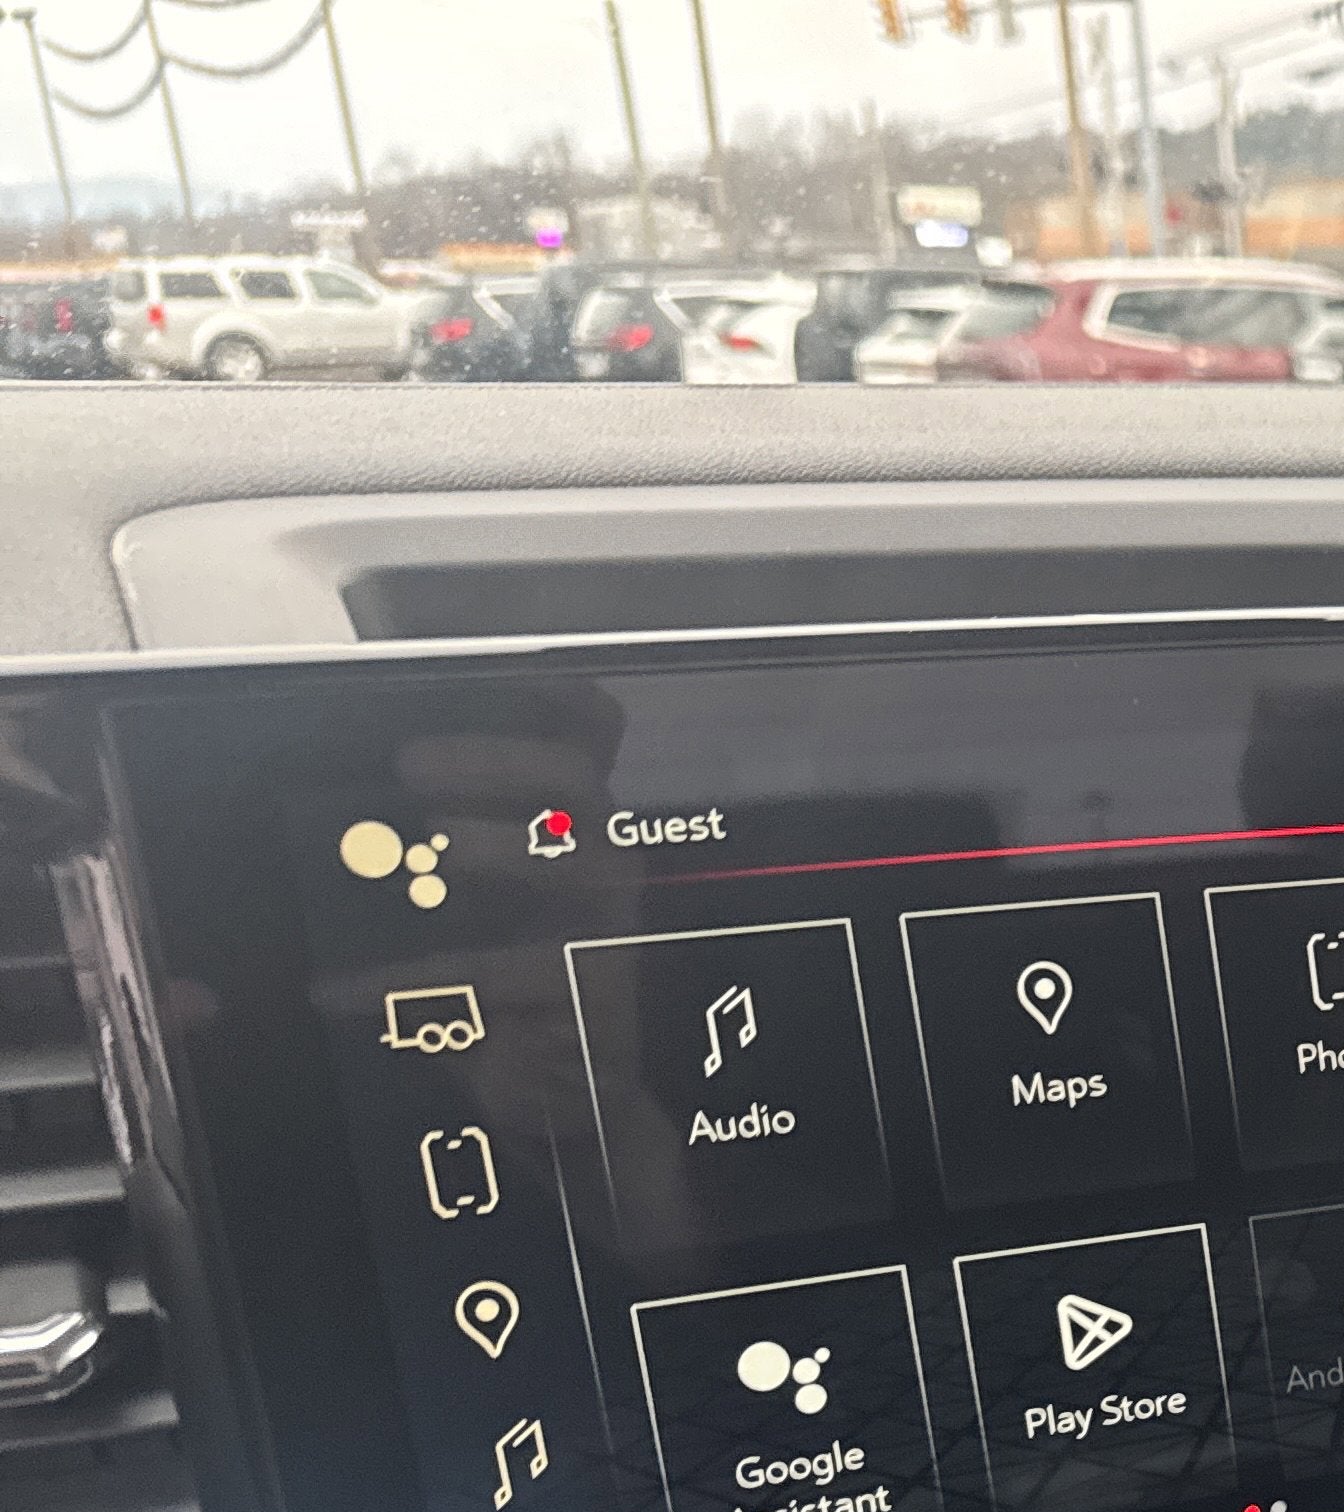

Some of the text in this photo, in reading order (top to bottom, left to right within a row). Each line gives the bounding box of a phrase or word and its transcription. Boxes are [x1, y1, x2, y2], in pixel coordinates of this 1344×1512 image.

[606, 806, 728, 849] Guest
[1011, 1071, 1108, 1109] Maps
[687, 1101, 797, 1146] Audio
[1024, 1389, 1188, 1441] Play Store
[734, 1439, 866, 1490] Google
